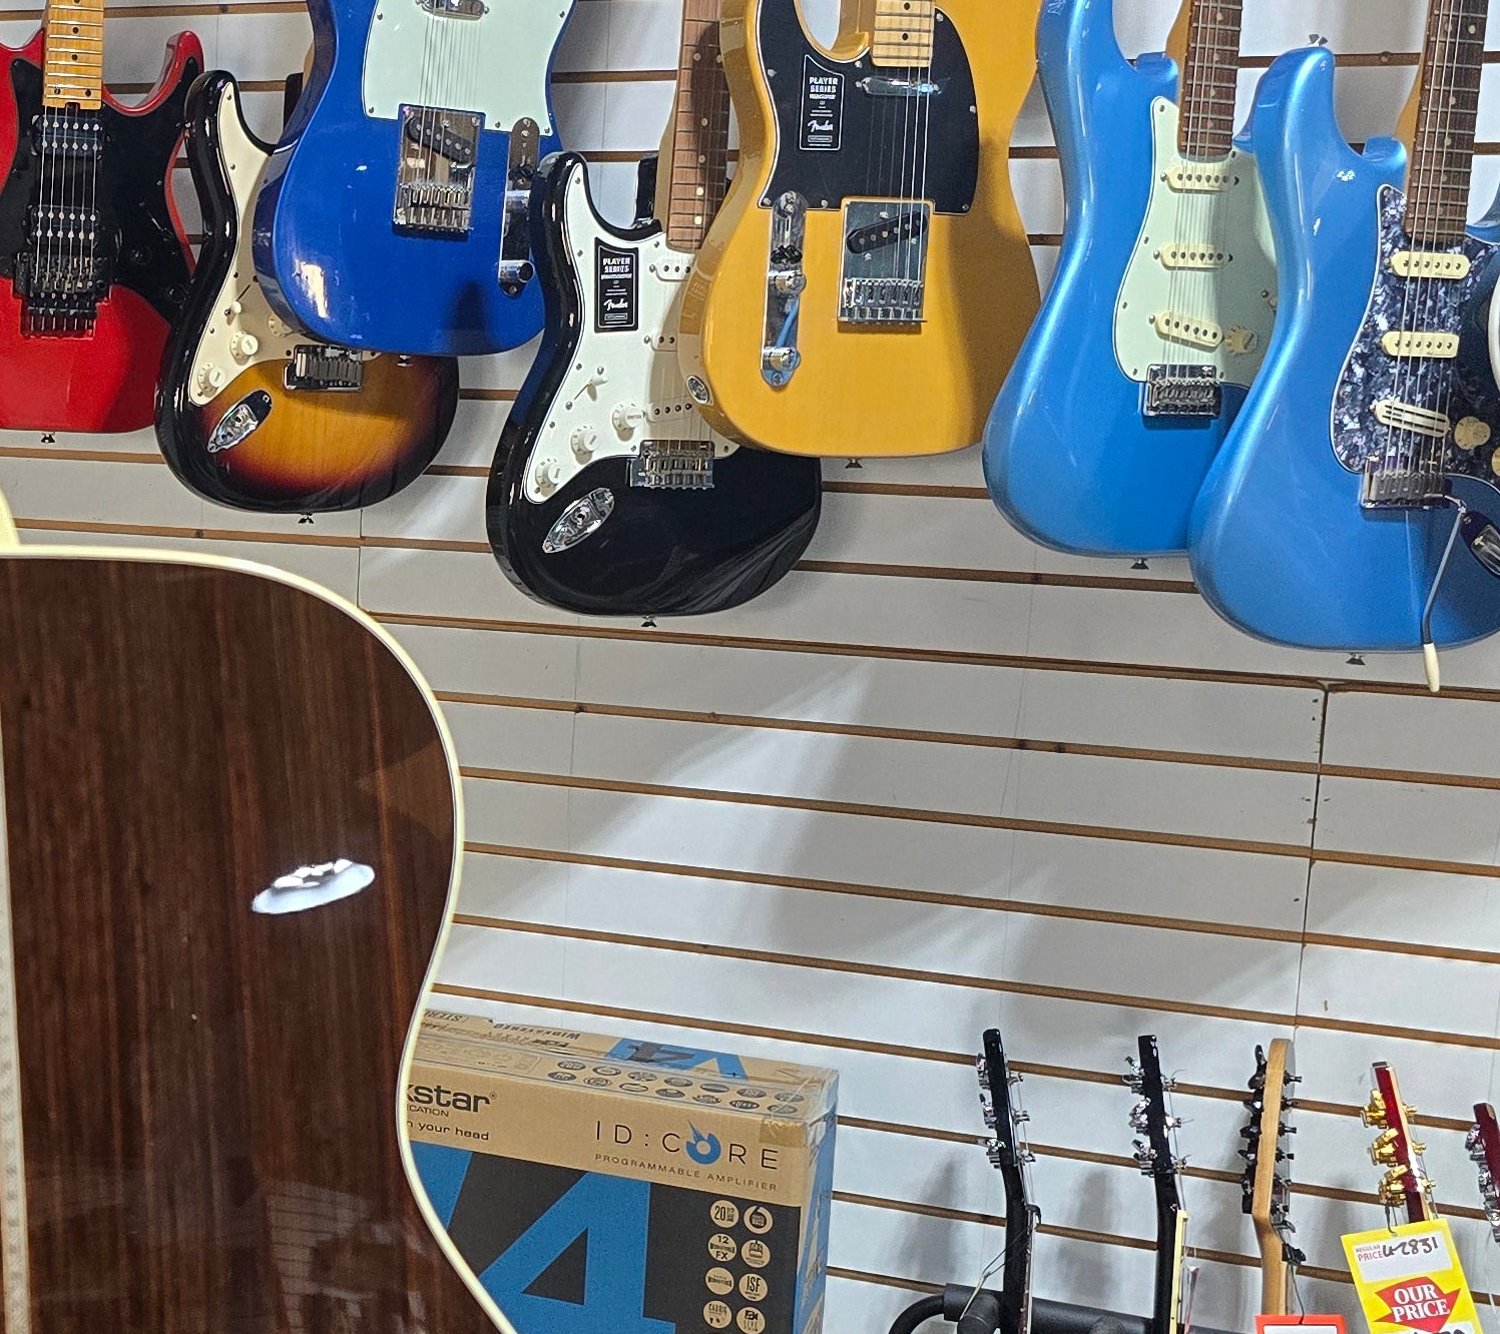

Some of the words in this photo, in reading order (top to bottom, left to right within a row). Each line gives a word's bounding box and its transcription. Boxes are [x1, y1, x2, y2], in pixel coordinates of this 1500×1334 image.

[809, 76, 838, 85] PLAYER
[602, 257, 631, 266] PLAYER
[418, 1122, 451, 1136] your
[455, 1127, 490, 1142] head
[595, 1153, 701, 1179] PROGRAMMABLE
[706, 1173, 778, 1192] AMPLIFIER
[714, 1205, 727, 1221] 20
[717, 1235, 730, 1245] 12
[715, 1250, 729, 1260] FX
[1358, 1250, 1385, 1262] PRICE
[746, 1275, 762, 1293] ISF
[1393, 1284, 1439, 1305] OUR
[1391, 1298, 1451, 1323] PRICE
